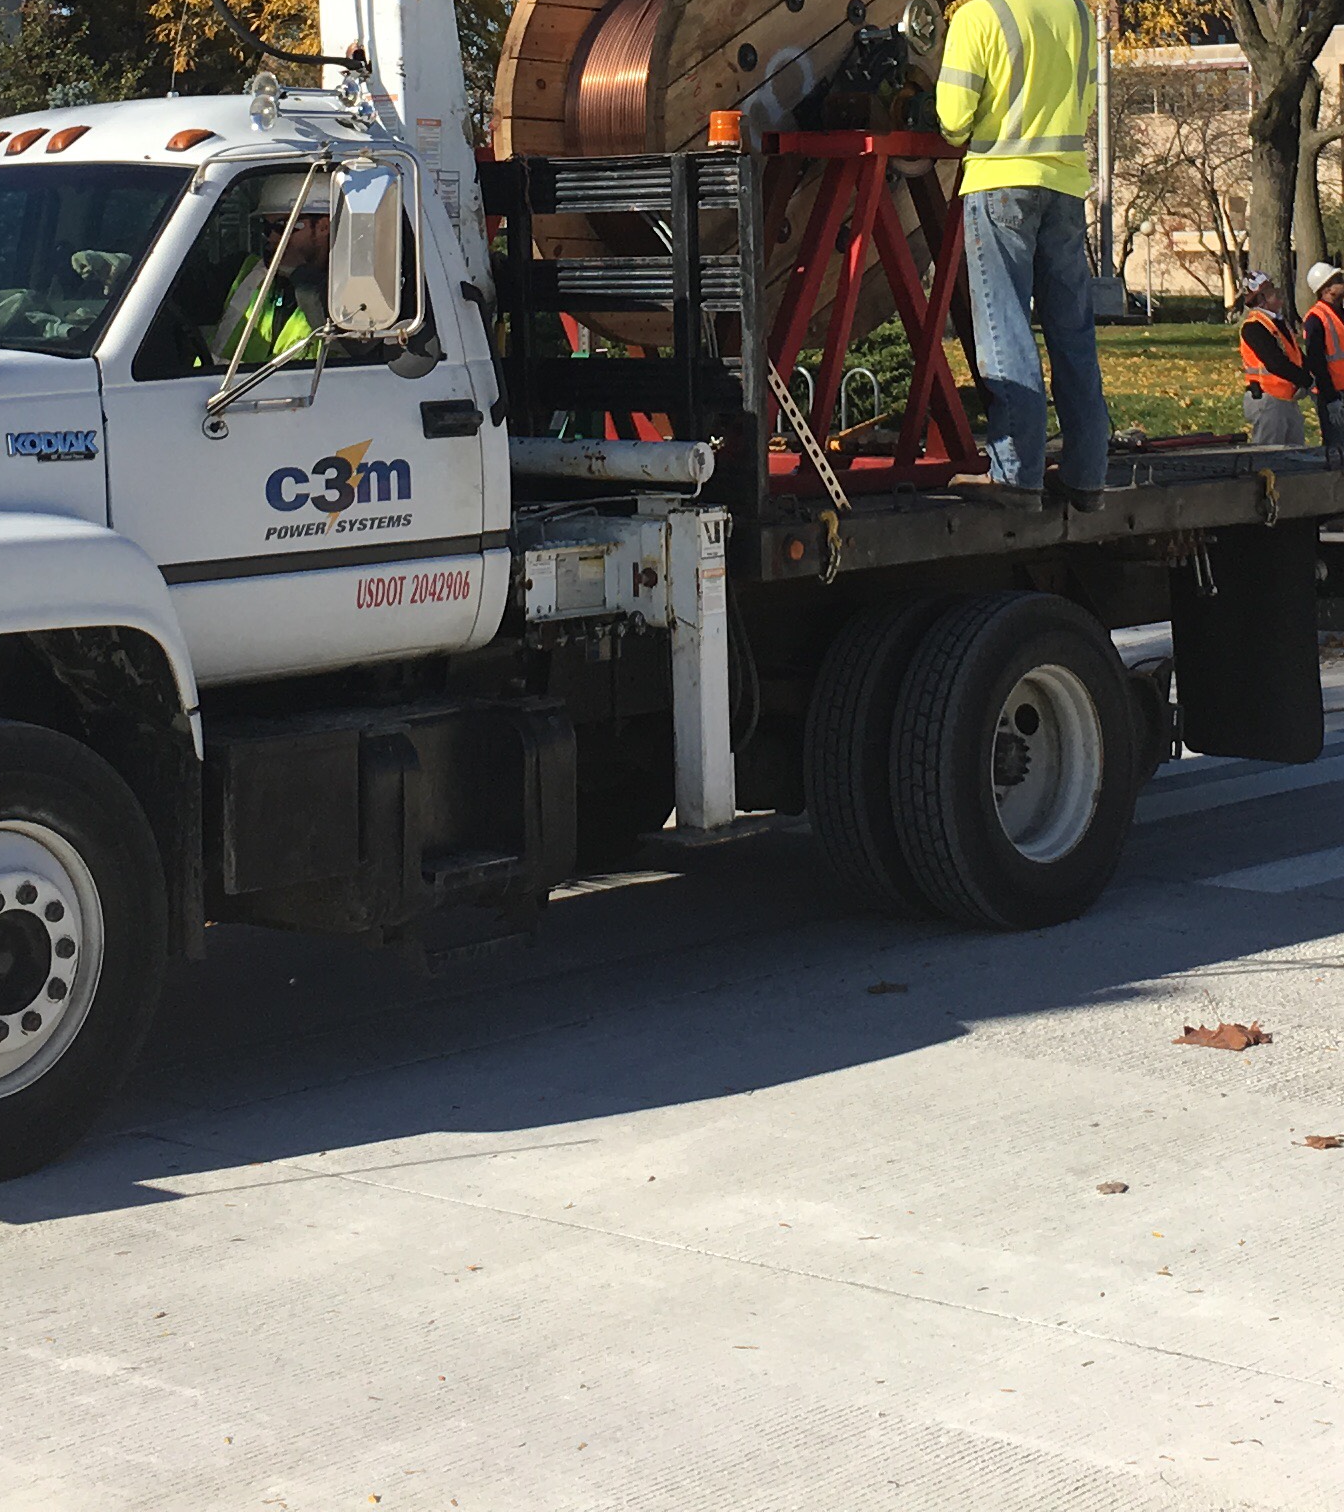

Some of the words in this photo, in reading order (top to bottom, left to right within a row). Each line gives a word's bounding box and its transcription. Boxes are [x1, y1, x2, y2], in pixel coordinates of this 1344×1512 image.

[6, 430, 99, 458] KODIAK
[265, 455, 412, 513] c3m
[264, 521, 327, 541] POWER
[335, 513, 413, 534] SYSTEMS
[357, 575, 406, 609] USDOT
[410, 570, 471, 604] 2042906
